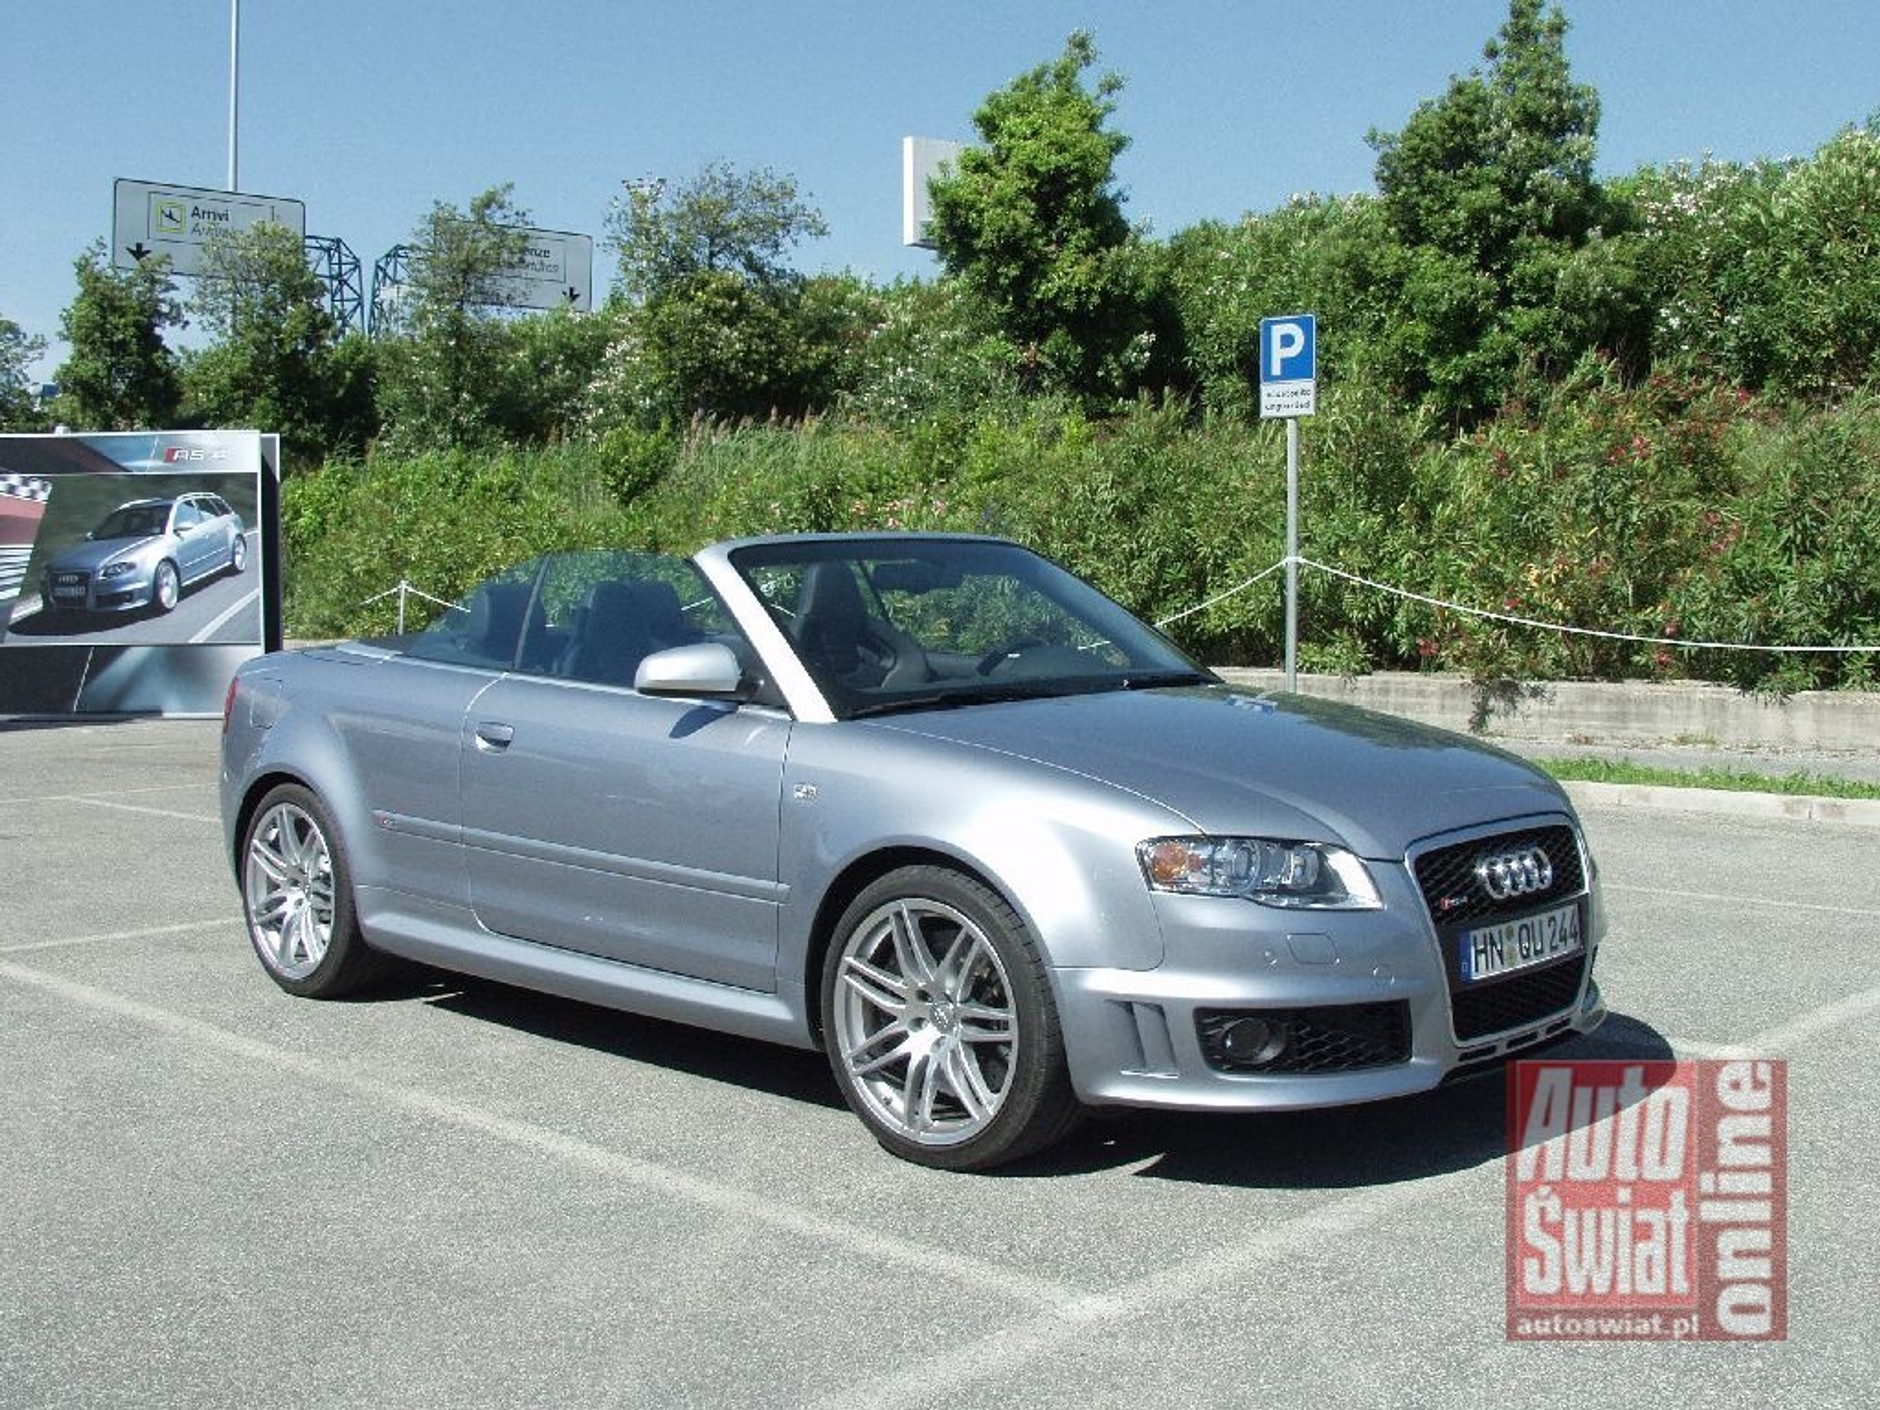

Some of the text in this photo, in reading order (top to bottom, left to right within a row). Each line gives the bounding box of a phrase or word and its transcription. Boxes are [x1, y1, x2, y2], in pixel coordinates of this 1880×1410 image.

[1270, 322, 1305, 376] P
[1473, 909, 1579, 973] HN QU 244
